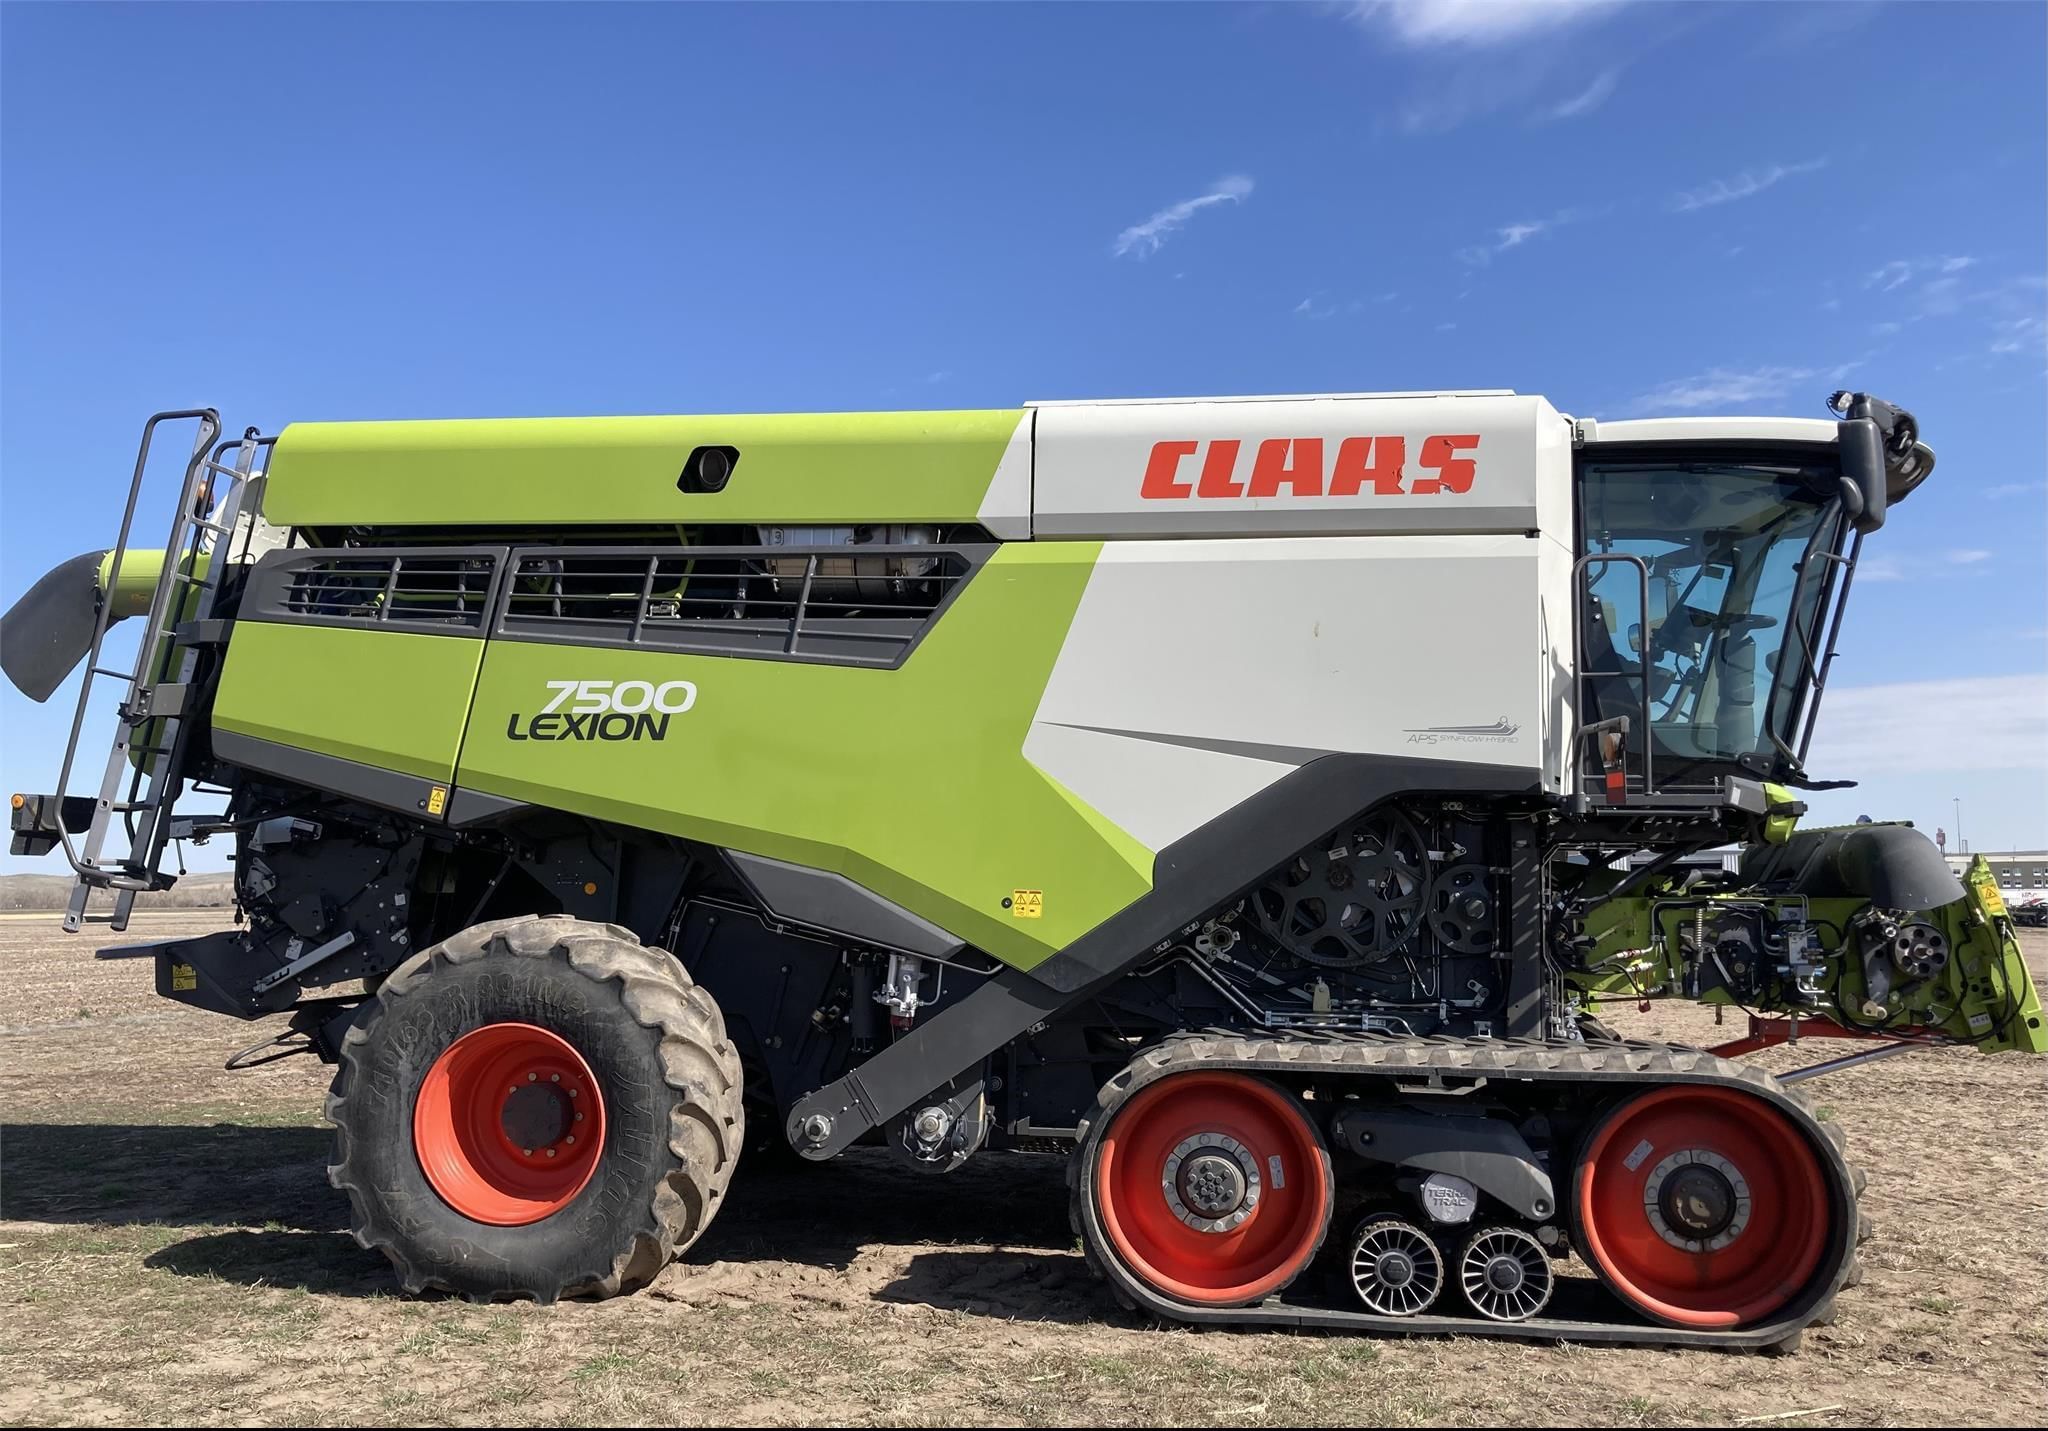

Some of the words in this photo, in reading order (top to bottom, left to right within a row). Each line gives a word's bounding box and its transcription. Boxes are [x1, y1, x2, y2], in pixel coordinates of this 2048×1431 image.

[1140, 434, 1481, 499] CLAAS
[540, 680, 698, 714] 7500
[507, 713, 671, 741] LEXION
[1406, 734, 1438, 745] APS
[1428, 1187, 1466, 1198] TERR
[1432, 1196, 1469, 1207] TRAC
